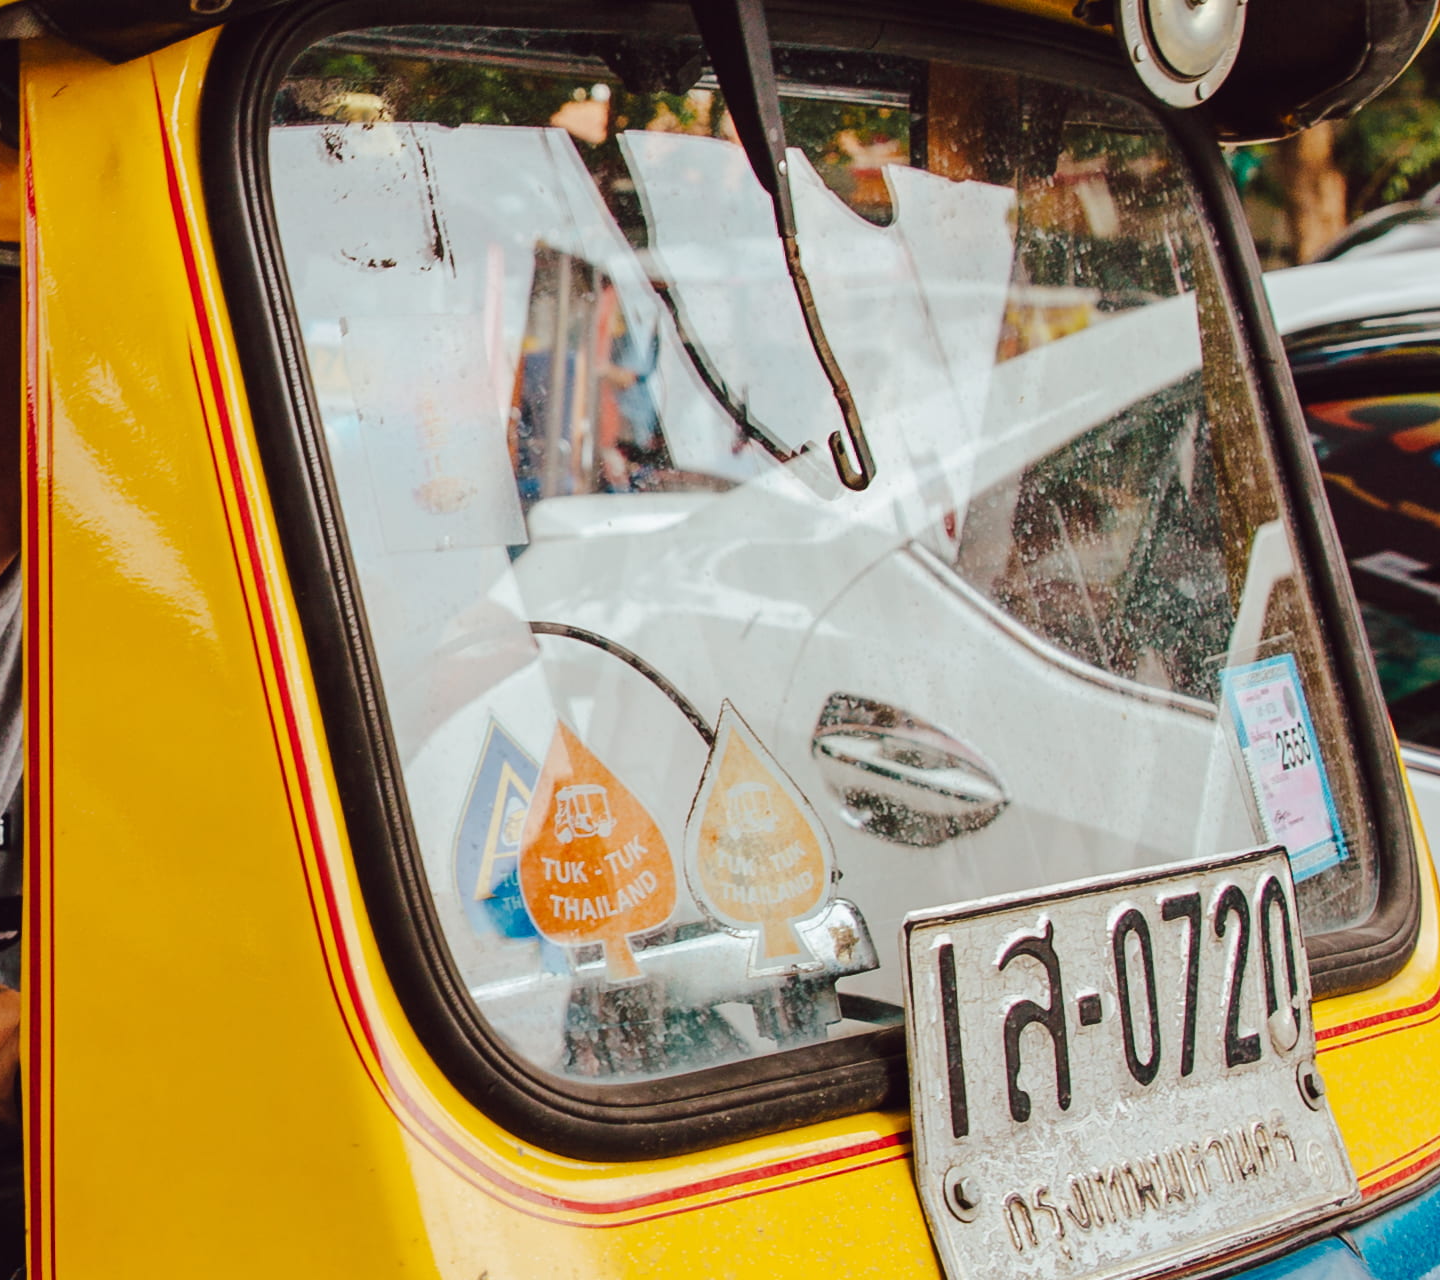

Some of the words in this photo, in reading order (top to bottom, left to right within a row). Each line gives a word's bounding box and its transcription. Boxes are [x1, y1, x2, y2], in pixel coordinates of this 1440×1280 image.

[540, 856, 589, 884] TUK
[603, 834, 649, 876] TUK
[769, 839, 807, 872] TUK
[548, 869, 658, 921] THAILAND
[720, 870, 815, 906] THAILAND
[1002, 1118, 1299, 1261] กรุงเทพมหานคร
